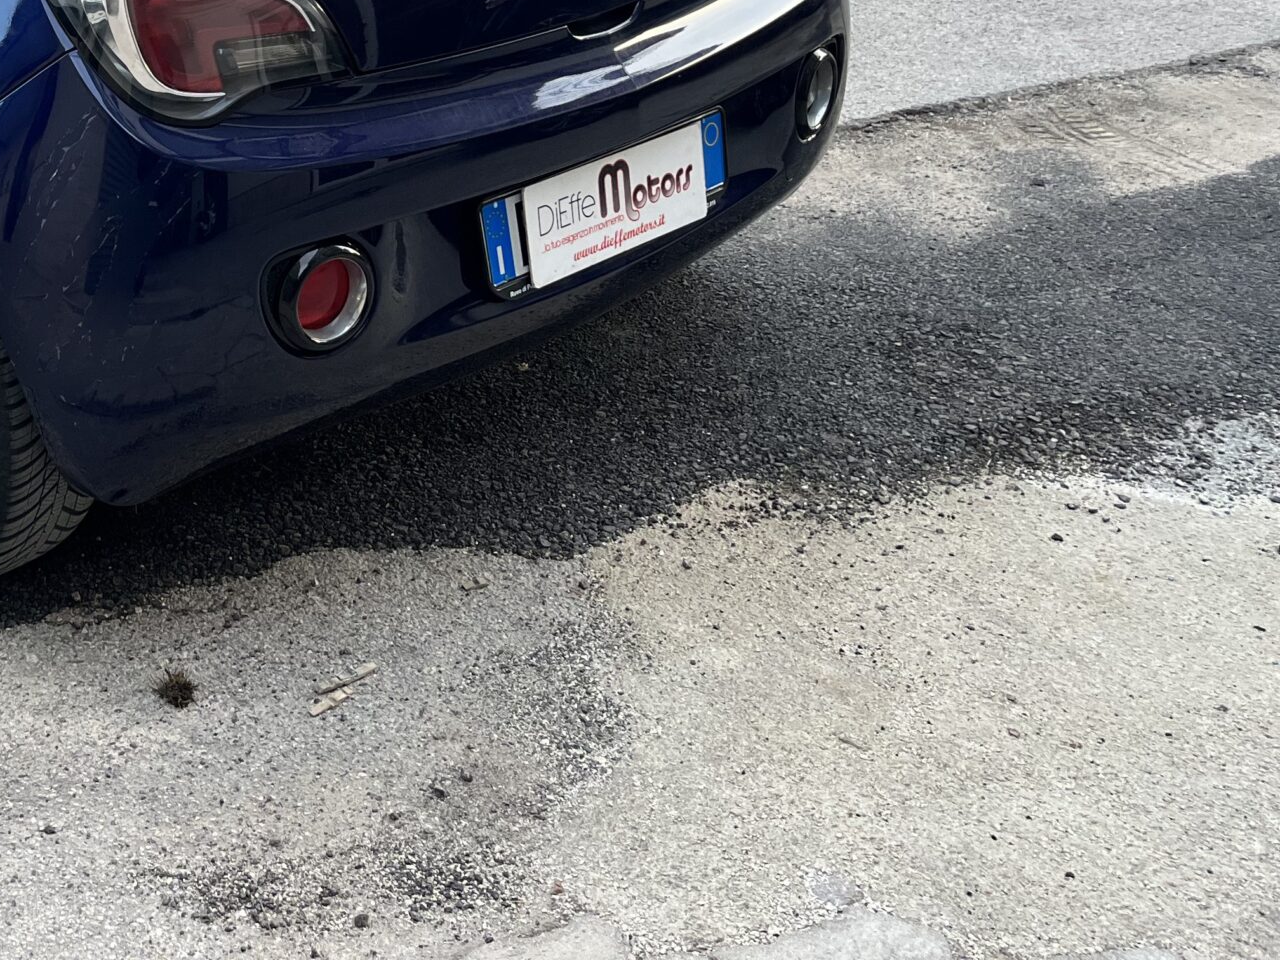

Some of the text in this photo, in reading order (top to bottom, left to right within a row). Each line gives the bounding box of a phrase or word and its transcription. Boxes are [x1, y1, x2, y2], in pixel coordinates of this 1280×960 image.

[537, 159, 692, 237] DiEffe Motors
[574, 213, 665, 261] www.dieffemotors.it
